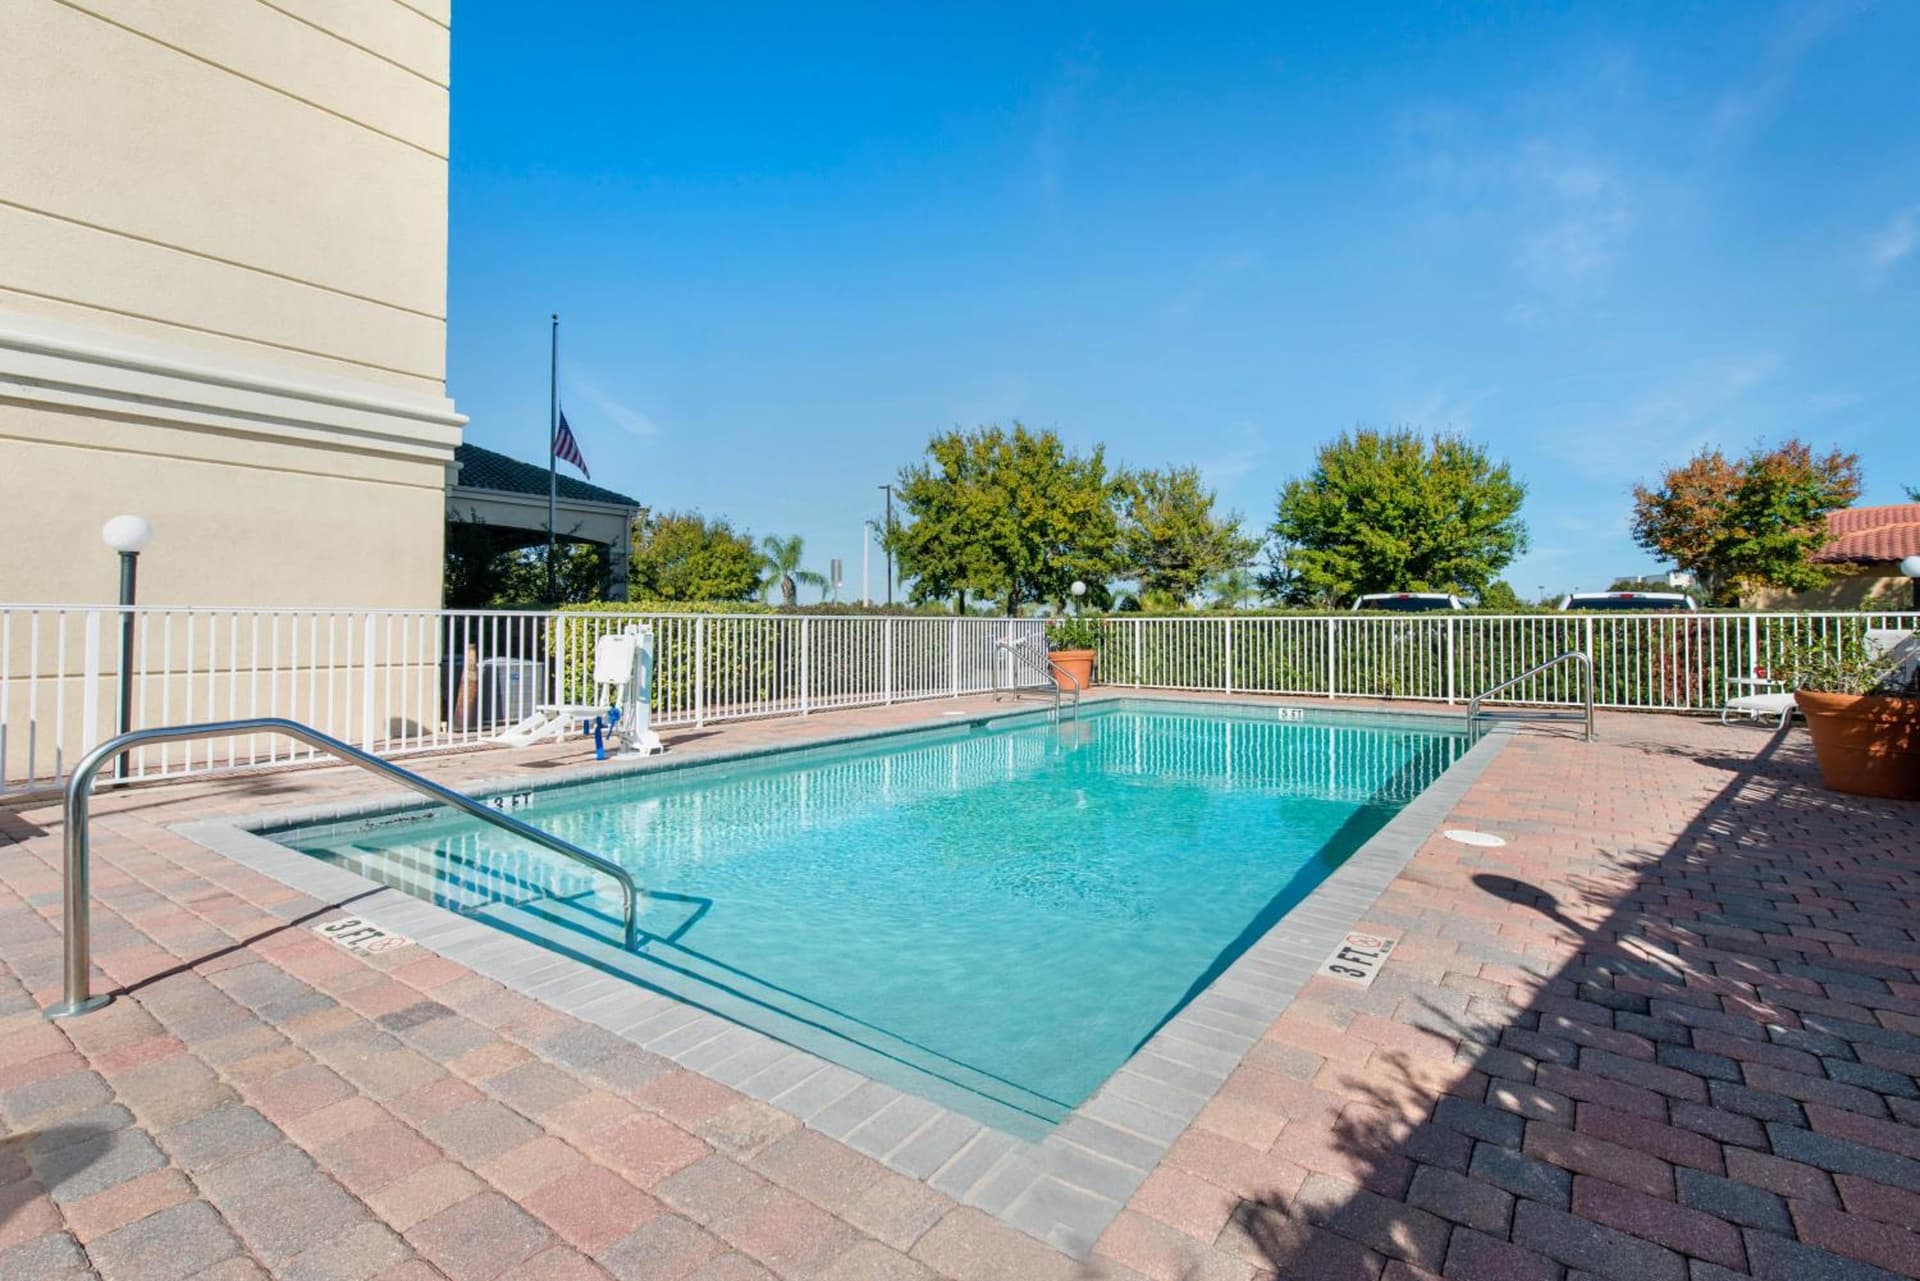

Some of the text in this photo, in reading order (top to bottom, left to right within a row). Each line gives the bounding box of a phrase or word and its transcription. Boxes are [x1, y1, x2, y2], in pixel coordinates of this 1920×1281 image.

[1291, 709, 1302, 720] FT
[511, 791, 532, 807] FT
[325, 919, 385, 946] 3 FT
[1328, 946, 1379, 978] 3 FT
